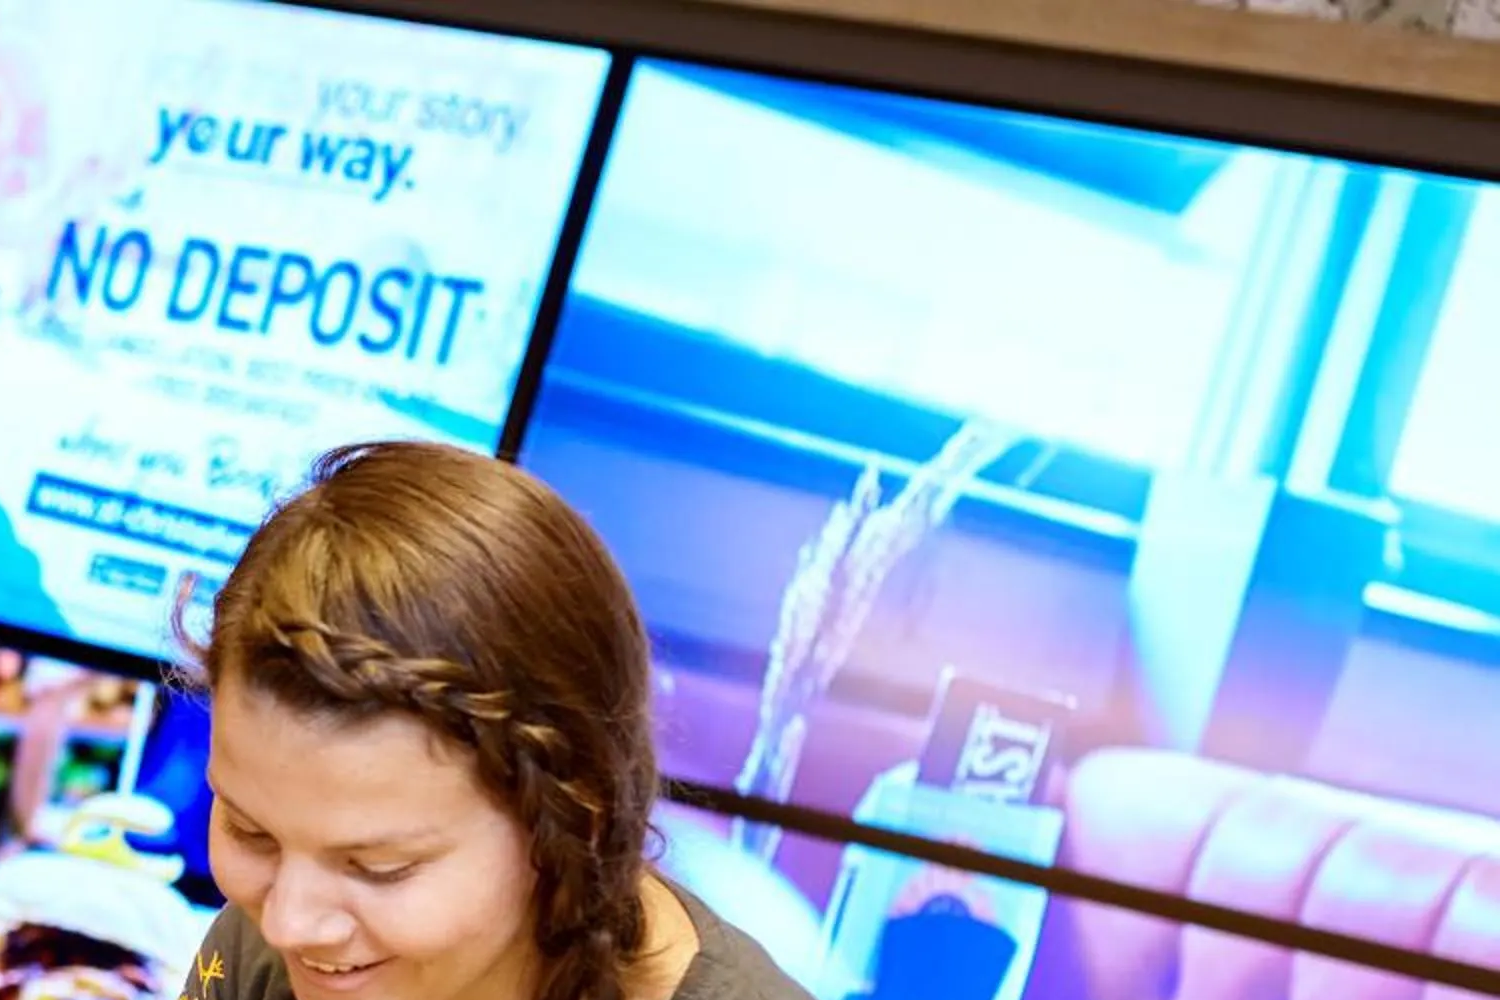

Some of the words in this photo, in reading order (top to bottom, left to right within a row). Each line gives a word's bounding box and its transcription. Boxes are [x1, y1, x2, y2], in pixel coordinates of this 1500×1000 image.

[149, 106, 287, 166] your
[299, 130, 416, 203] way.
[46, 221, 152, 311] NO
[166, 237, 485, 365] DEPOSIT
